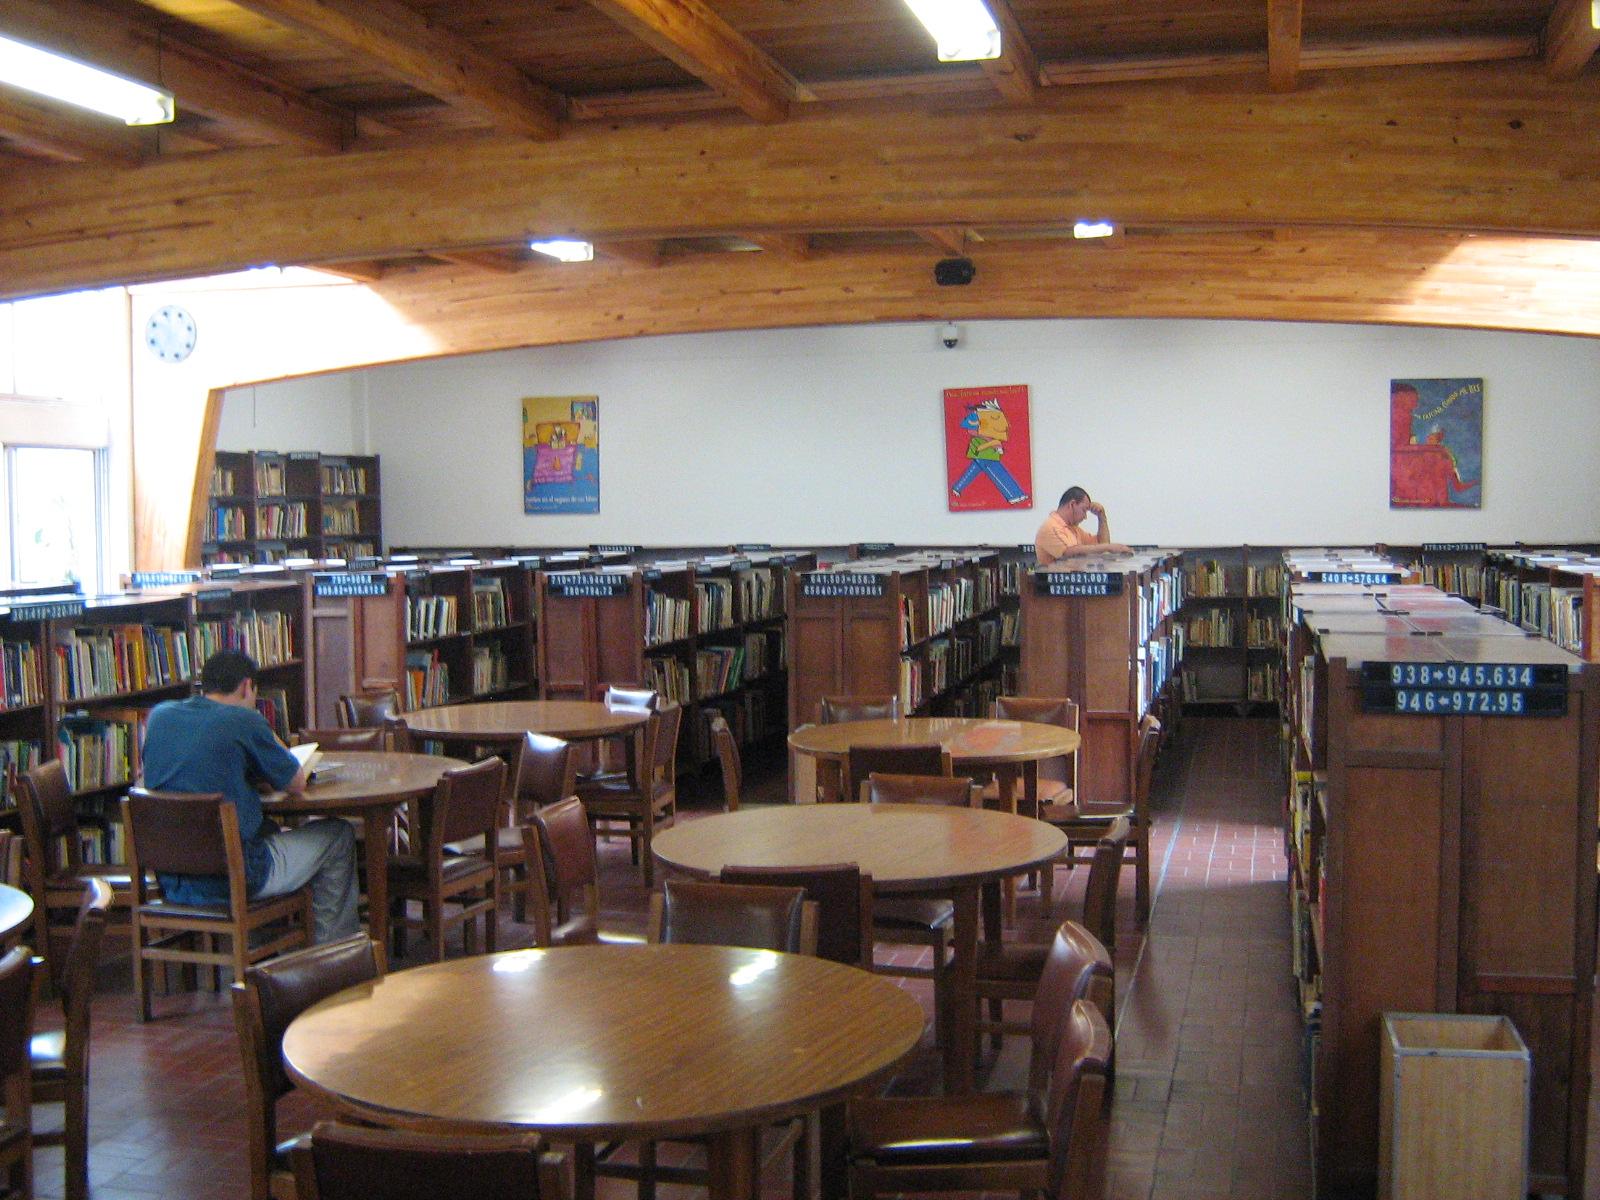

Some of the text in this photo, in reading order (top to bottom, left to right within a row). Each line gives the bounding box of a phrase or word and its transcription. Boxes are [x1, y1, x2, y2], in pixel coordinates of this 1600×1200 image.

[1322, 573, 1339, 582] 540
[1354, 574, 1387, 584] 576.64
[1392, 665, 1532, 687] 938 945.634
[1397, 692, 1523, 712] 946 972.95
